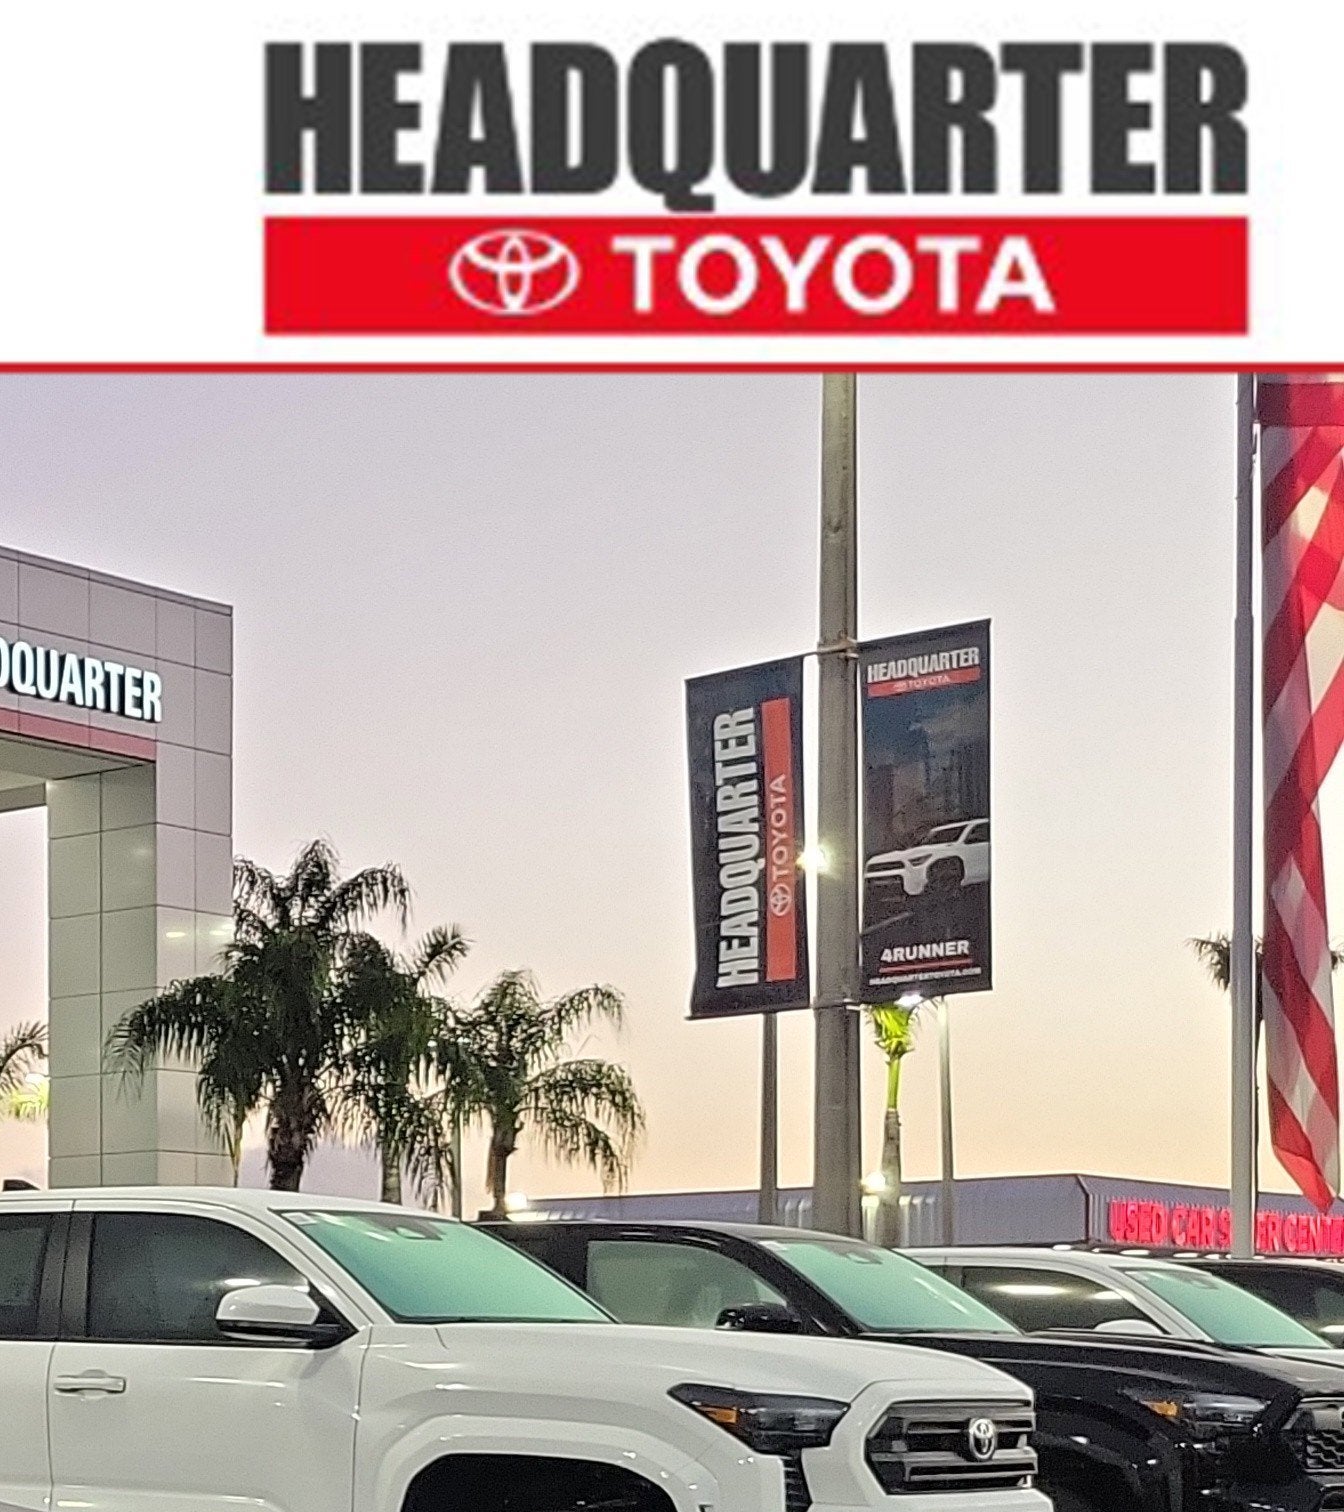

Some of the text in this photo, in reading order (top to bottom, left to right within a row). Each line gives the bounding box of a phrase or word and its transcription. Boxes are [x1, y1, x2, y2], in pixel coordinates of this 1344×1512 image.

[867, 646, 980, 683] HEADQUARTER
[714, 706, 765, 989] HEADQUARTER
[770, 773, 789, 883] TOYOTA
[880, 939, 970, 962] 4RUNNER
[1109, 1200, 1167, 1244] USED
[1172, 1206, 1215, 1248] CAR
